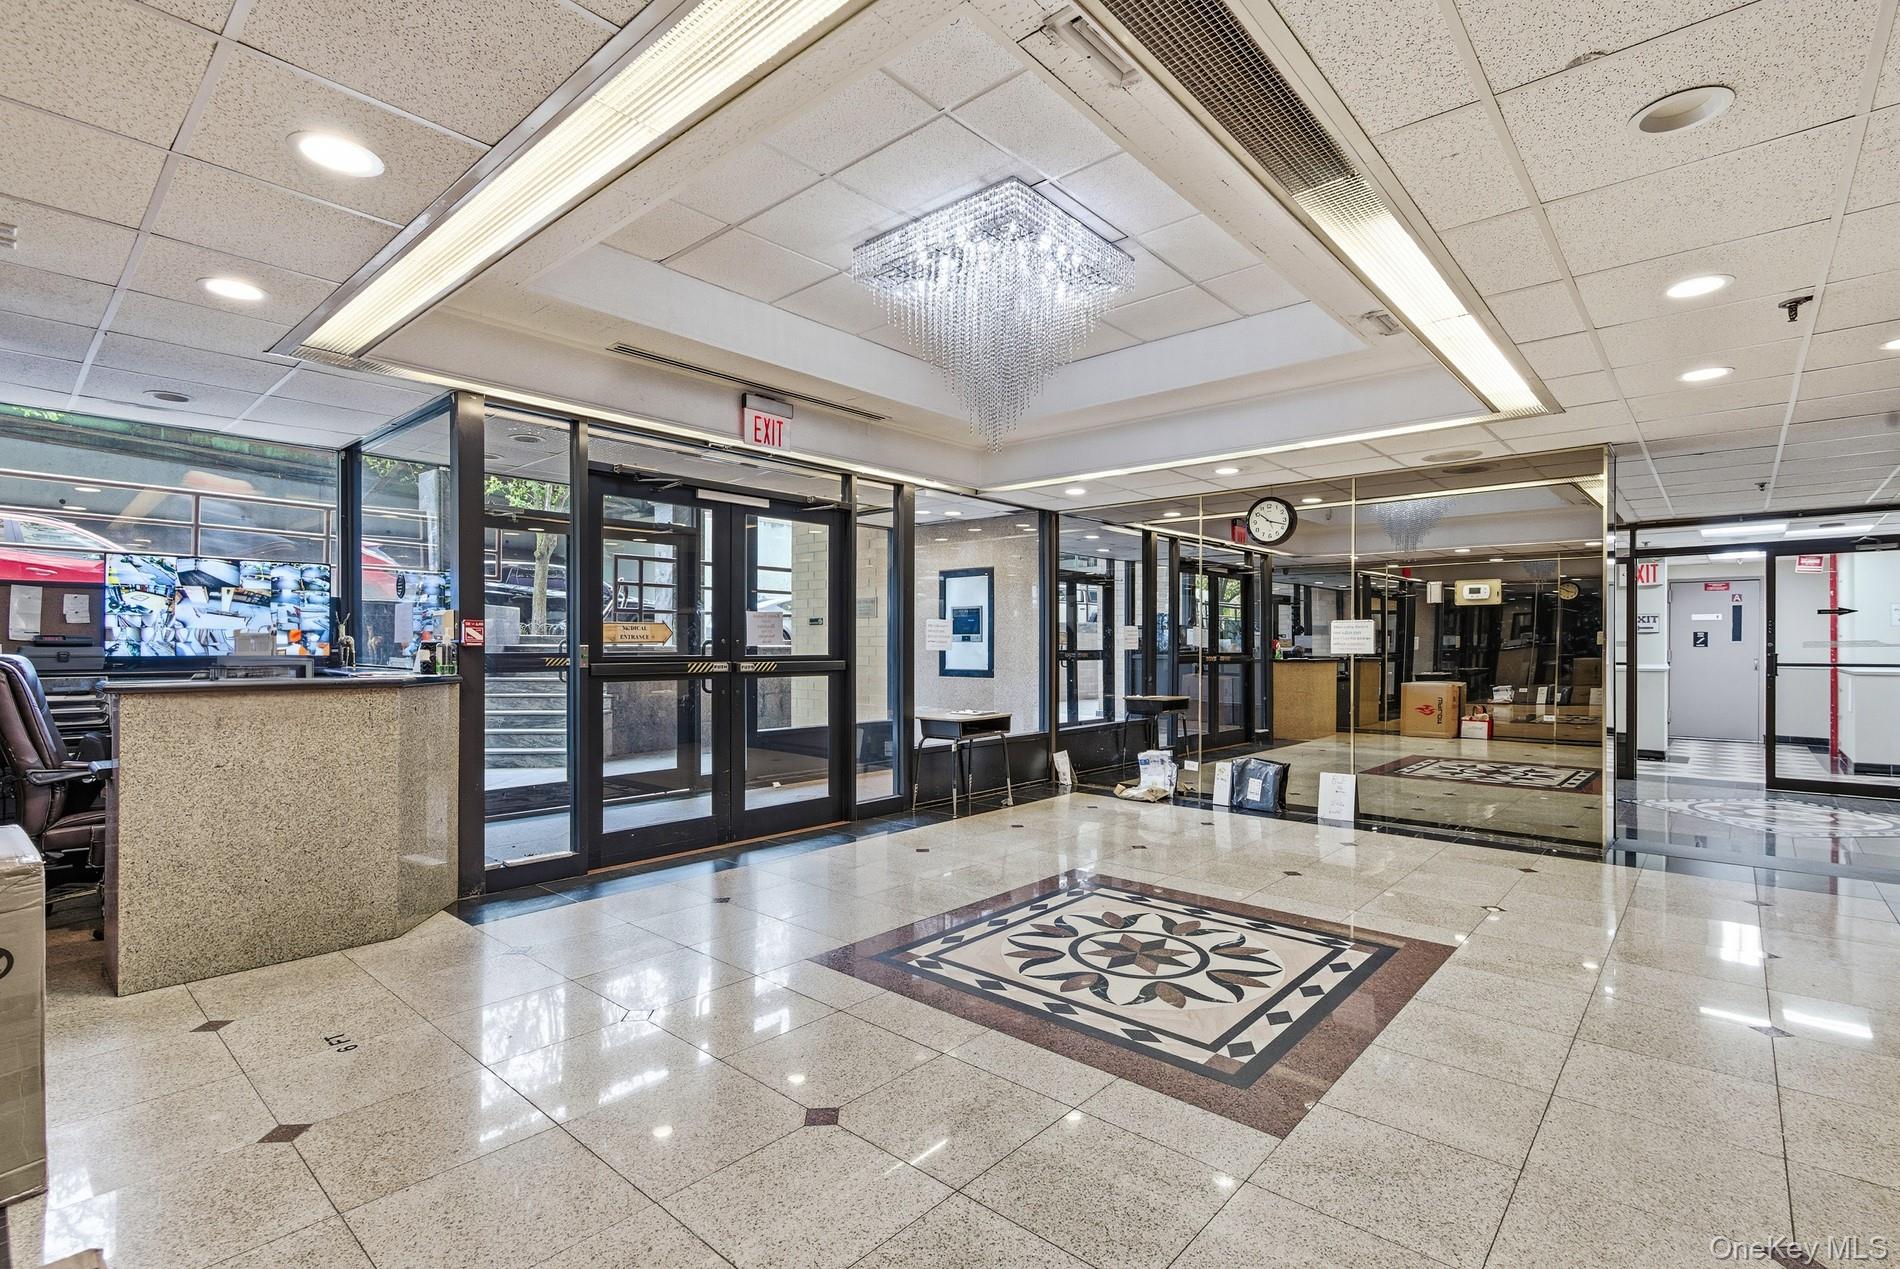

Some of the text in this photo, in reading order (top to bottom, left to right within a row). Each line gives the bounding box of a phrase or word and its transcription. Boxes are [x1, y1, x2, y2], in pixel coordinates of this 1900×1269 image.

[754, 415, 783, 447] EXIT
[1637, 563, 1659, 583] XIT
[1637, 615, 1659, 624] XIT
